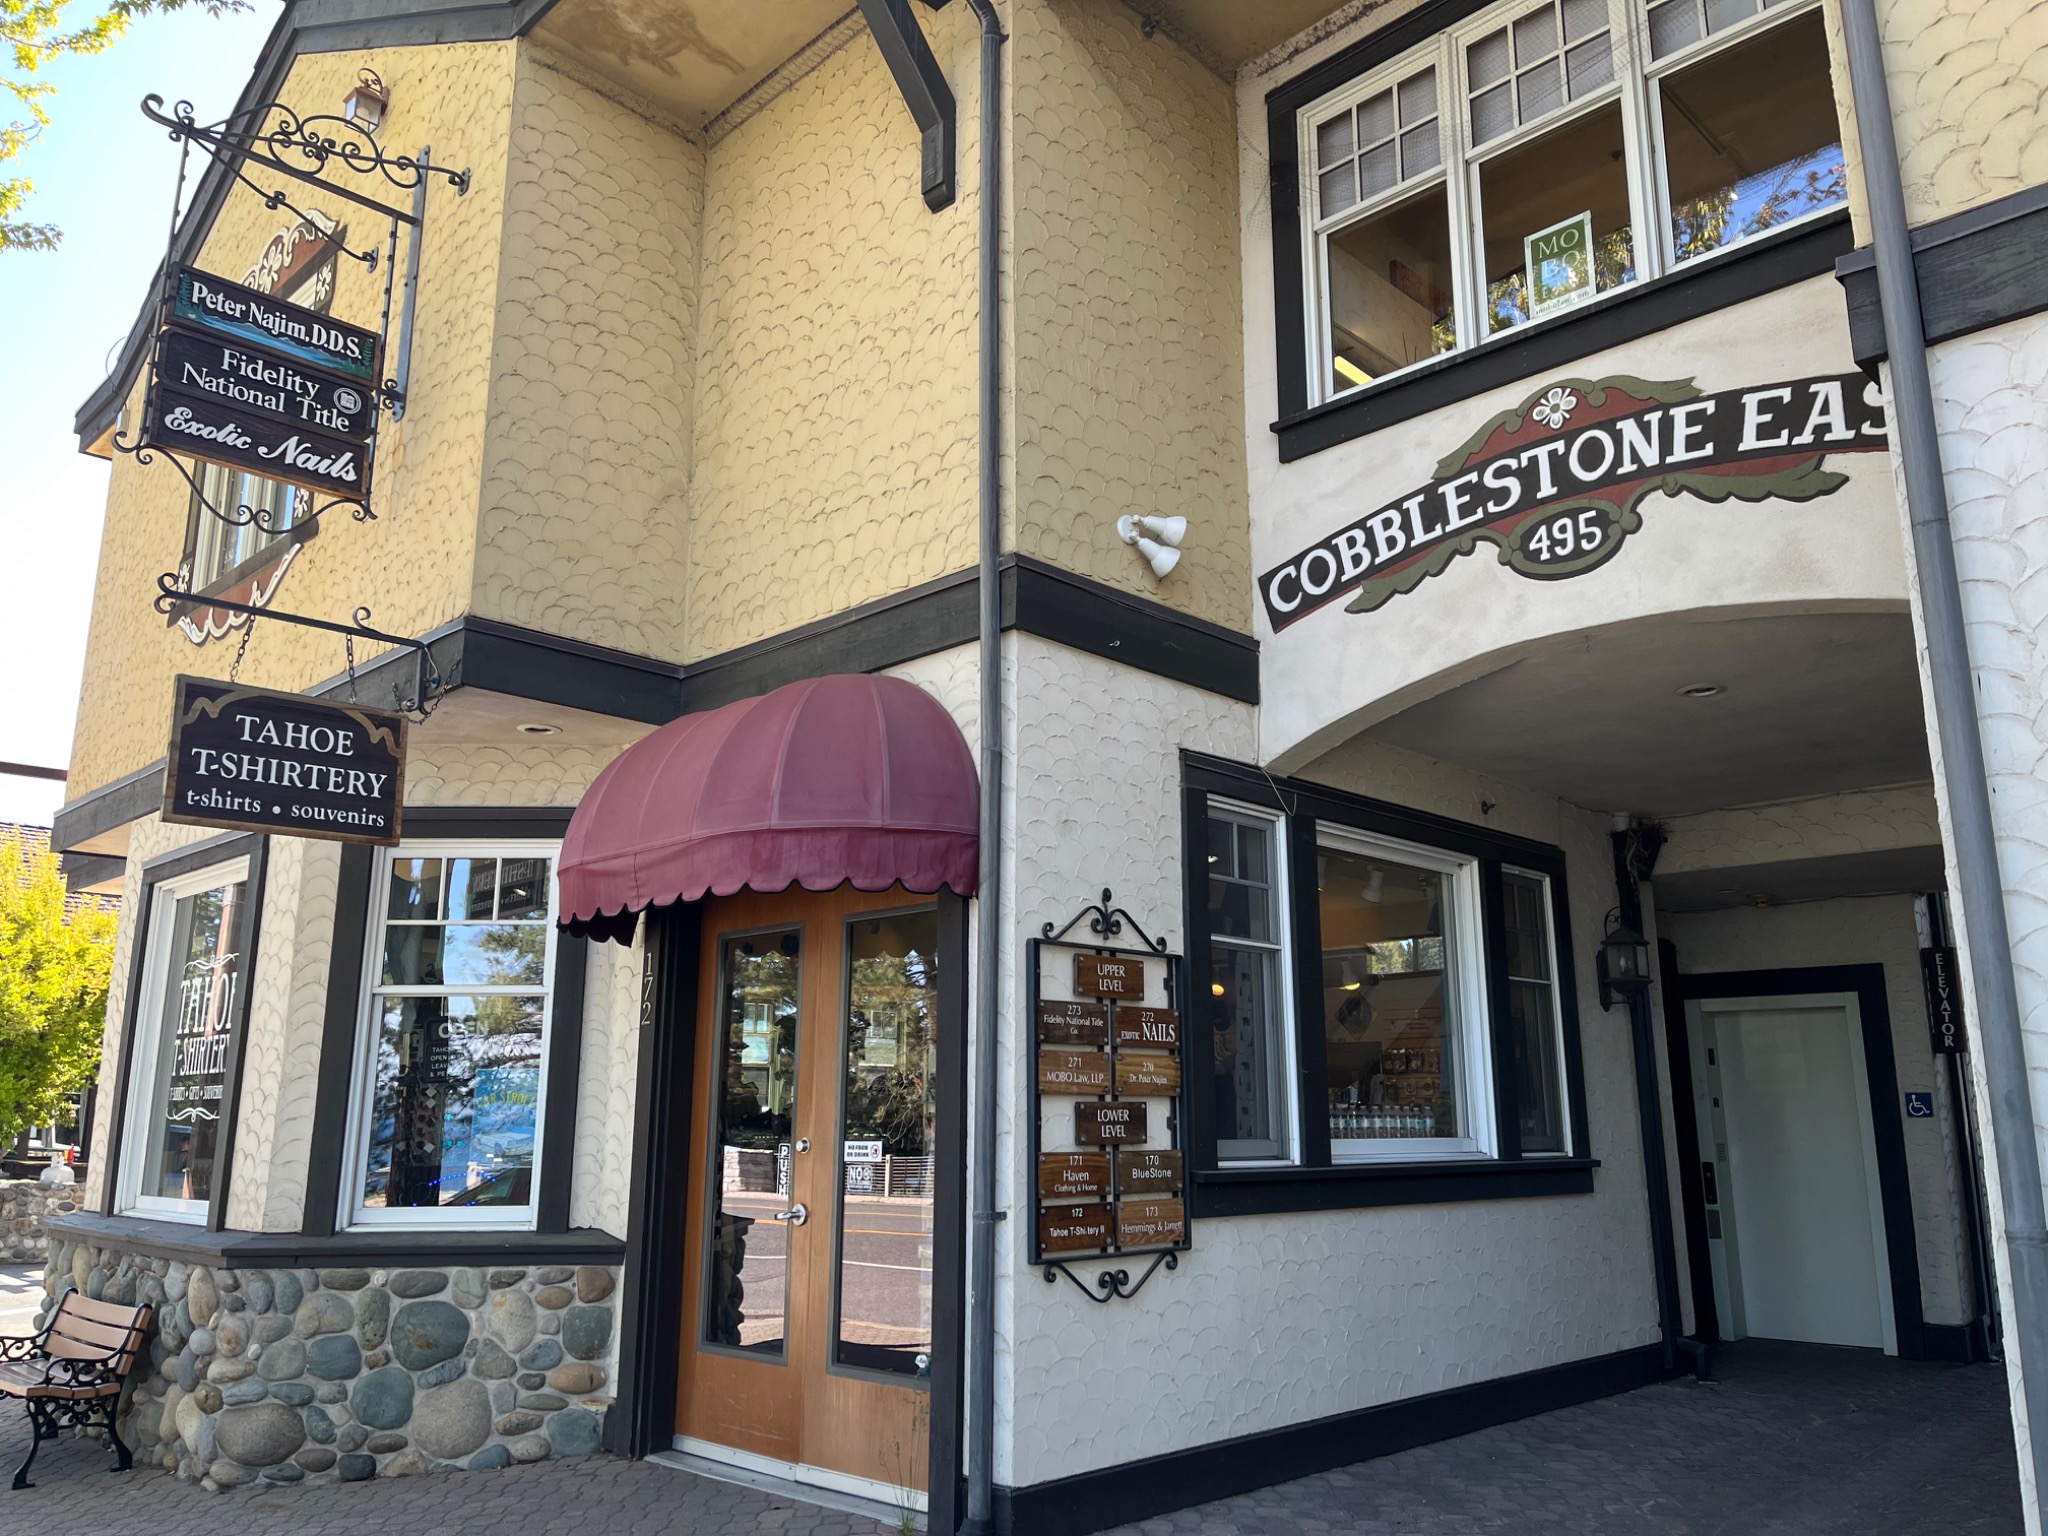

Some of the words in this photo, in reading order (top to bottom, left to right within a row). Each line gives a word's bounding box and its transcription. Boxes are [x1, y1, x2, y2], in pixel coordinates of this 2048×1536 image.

[1538, 229, 1579, 259] MO
[191, 281, 246, 319] Peter
[249, 302, 310, 343] Najim,
[311, 323, 363, 360] D.D.S.
[220, 348, 321, 399] Fidelity
[181, 362, 286, 413] National
[296, 397, 350, 432] Title
[164, 406, 253, 450] Exotic
[257, 436, 358, 482] Nails
[1268, 394, 1716, 615] COBBLESTONE
[1528, 509, 1603, 562] 495
[235, 714, 354, 757] TAHOE
[191, 748, 388, 799] T-SHIRTERY
[187, 787, 262, 813] t-shirts
[290, 804, 385, 827] souvenirs
[1097, 963, 1125, 977] UPPER
[641, 952, 653, 1026] 172
[1099, 978, 1124, 992] LEVEL
[1935, 953, 1955, 1047] ELEVATOR
[1067, 1005, 1082, 1015] 273
[1043, 1015, 1066, 1026] Fidelity
[1066, 1016, 1091, 1027] National
[1091, 1017, 1104, 1027] Title
[1141, 1012, 1154, 1022] 272
[1121, 1030, 1140, 1040] EXOTIC
[1142, 1022, 1176, 1042] NAILS
[1068, 1057, 1082, 1068] 271
[1142, 1062, 1154, 1072] 270
[1046, 1071, 1073, 1083] MOBO
[1073, 1072, 1090, 1084] Law,
[1091, 1072, 1104, 1083] LLP
[1138, 1074, 1151, 1084] Peter
[1152, 1075, 1168, 1086] Najim
[1097, 1109, 1130, 1122] LOWER
[1101, 1125, 1126, 1138] LEVEL
[1069, 1156, 1083, 1166] 171
[1145, 1155, 1159, 1165] 170
[779, 1146, 789, 1197] PUSH
[850, 1166, 863, 1180] NO
[1063, 1170, 1089, 1182] Haven
[1054, 1183, 1076, 1194] Clothing
[1076, 1184, 1082, 1192] &
[1082, 1184, 1098, 1192] Home
[1072, 1208, 1083, 1217] 172
[1145, 1206, 1159, 1217] 173
[1049, 1227, 1069, 1237] Tahoe
[1121, 1222, 1156, 1235] Hemmings
[1157, 1222, 1163, 1231] &
